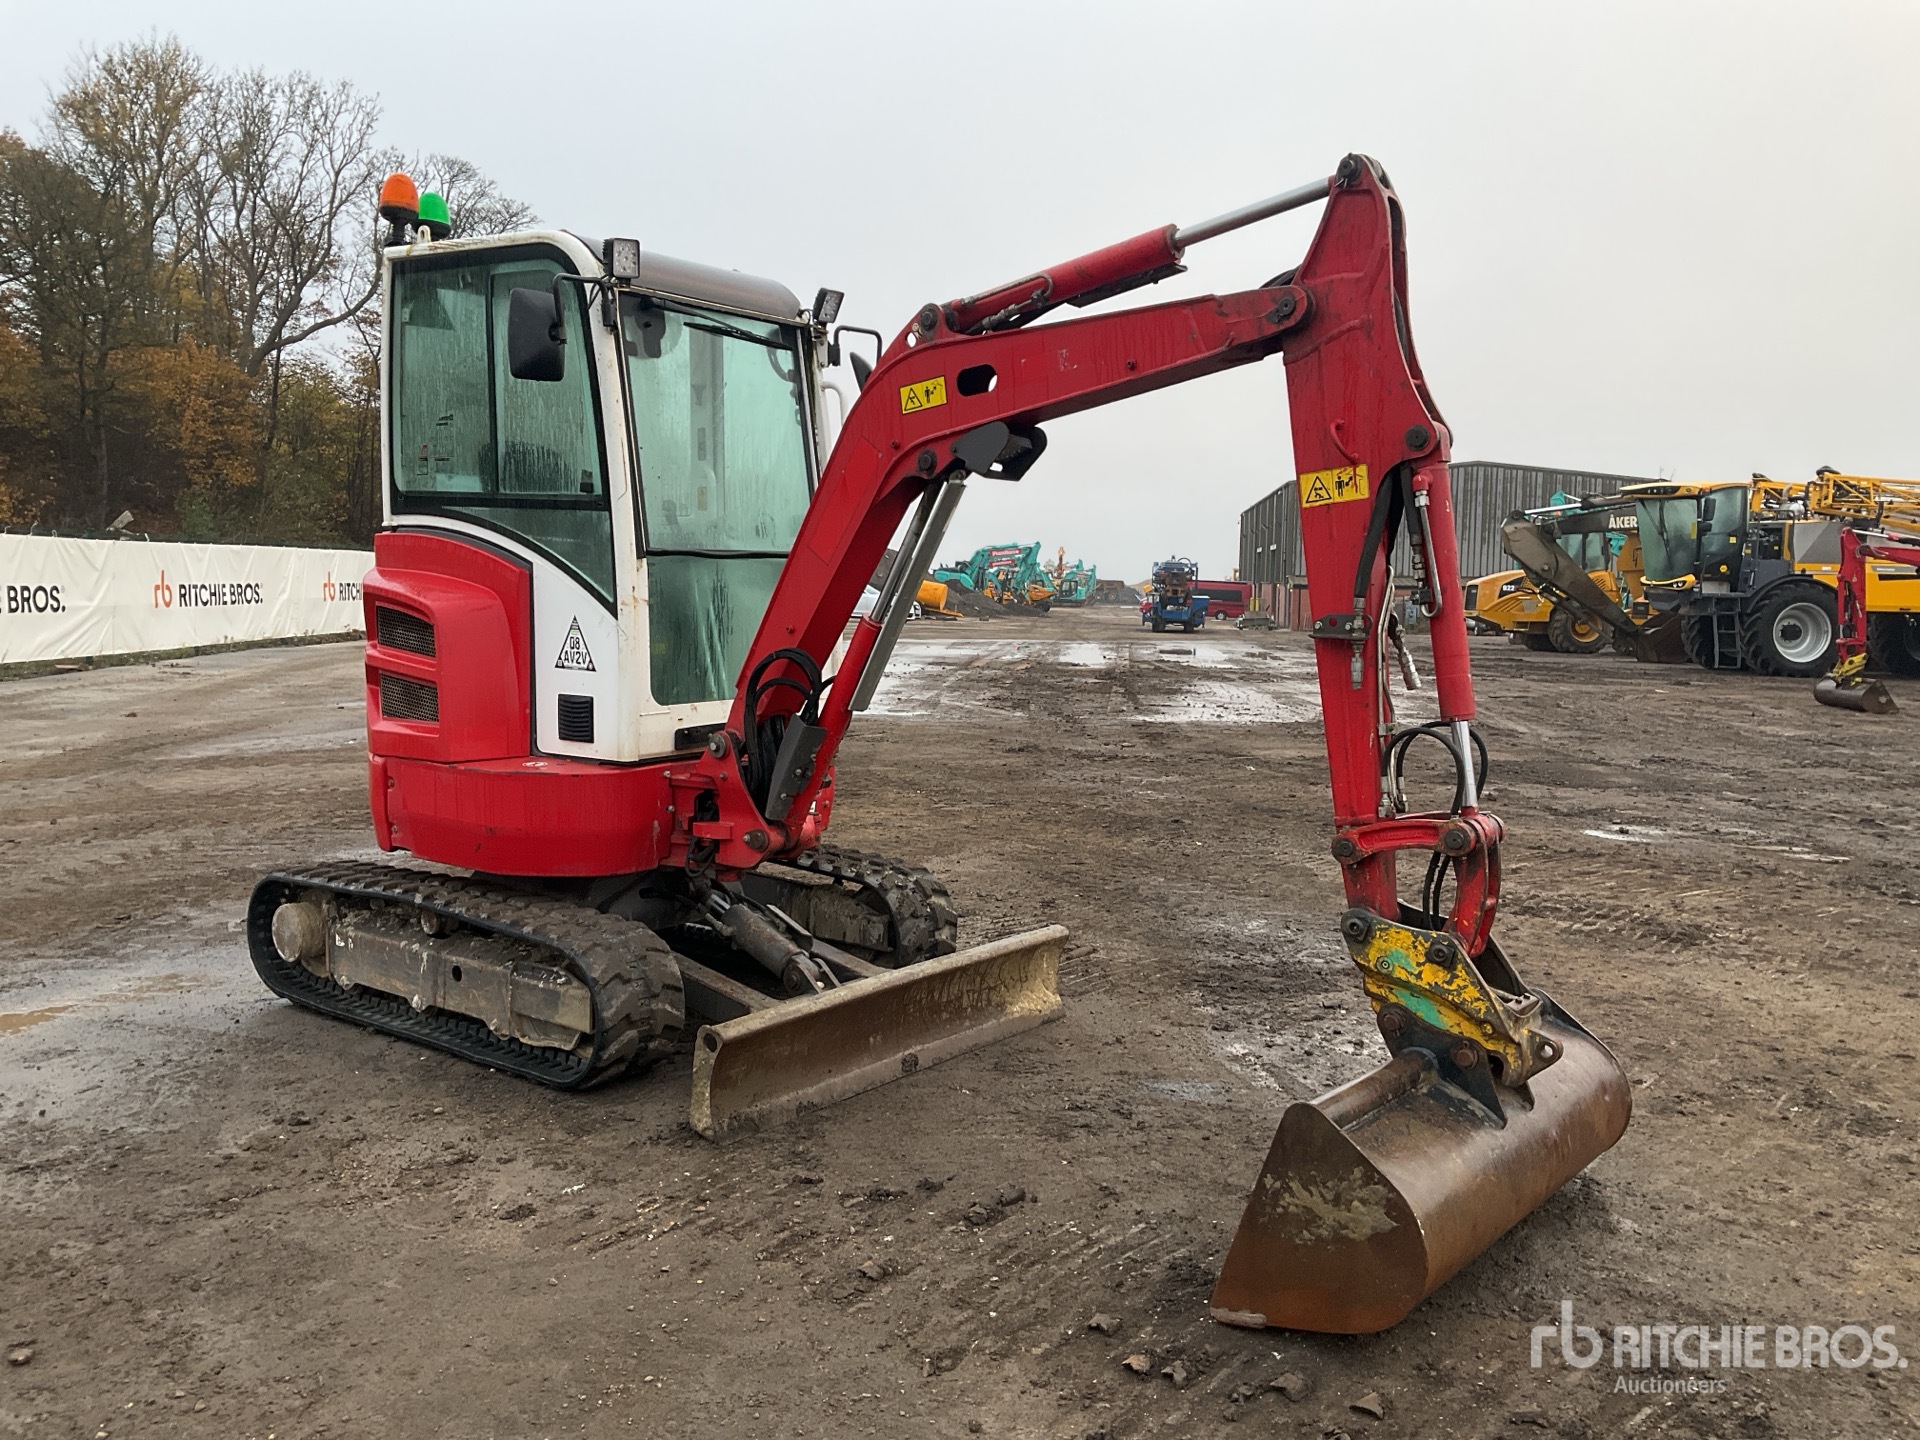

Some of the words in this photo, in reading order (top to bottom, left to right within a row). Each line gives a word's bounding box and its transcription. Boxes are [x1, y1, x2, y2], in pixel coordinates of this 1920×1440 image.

[7, 585, 66, 613] BROS.
[179, 583, 228, 607] RITCHIE
[229, 583, 263, 606] BROS.
[564, 650, 587, 665] AV2V
